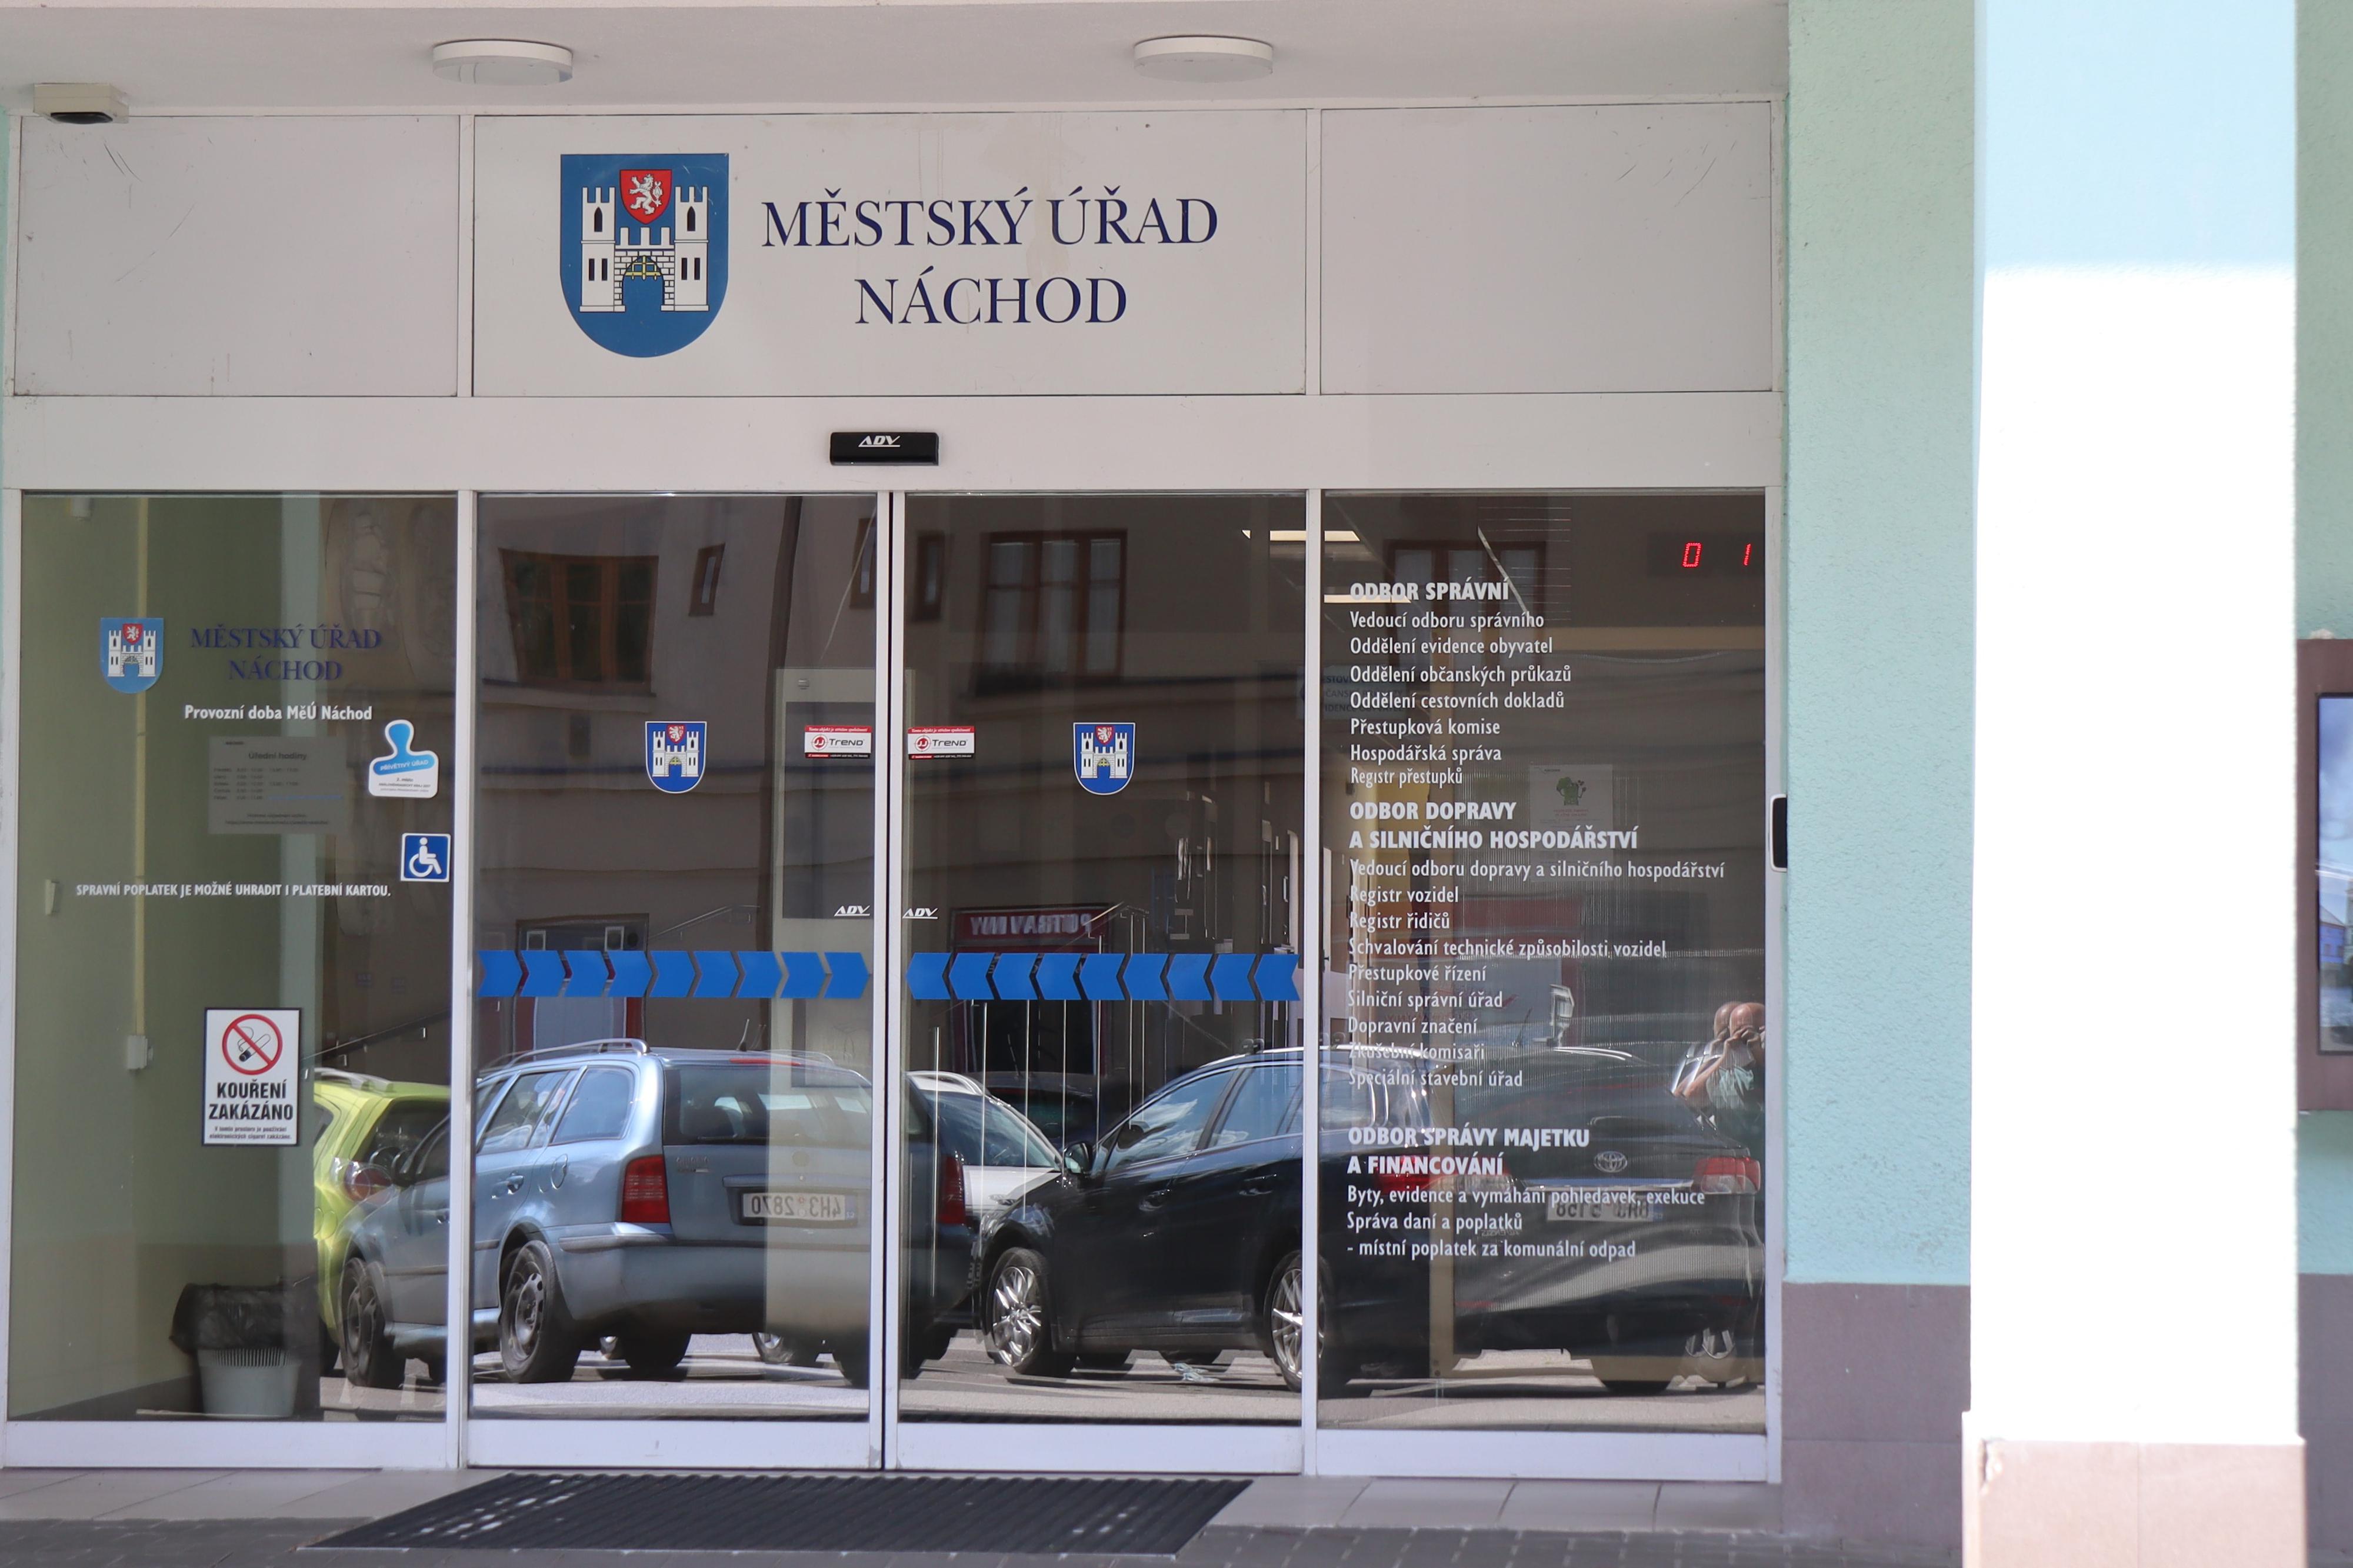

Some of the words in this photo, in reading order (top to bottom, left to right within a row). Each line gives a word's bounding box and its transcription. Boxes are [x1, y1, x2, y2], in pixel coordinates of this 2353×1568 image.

[761, 186, 1034, 248] MĚSTSKÝ
[1045, 185, 1218, 245] ÚŘAD
[854, 265, 1127, 325] NÁCHOD
[858, 435, 901, 448] ADV
[1350, 582, 1419, 600] ODBOR
[1425, 578, 1509, 600] SPRÁVNÍ
[1350, 611, 1407, 628] Vedoucí
[1412, 613, 1464, 628] odboru
[1470, 611, 1544, 632] správního
[191, 623, 305, 648] MĚSTSKÝ
[309, 623, 382, 648] ÚŘAD
[1350, 637, 1415, 654] Oddělení
[1421, 639, 1484, 653] evidence
[1489, 637, 1552, 658] obyvatel
[228, 655, 342, 680] NÁCHOD
[1350, 665, 1415, 683] Oddělení
[1420, 665, 1505, 686] občanských
[1511, 665, 1572, 686] průkazů
[185, 705, 245, 719] Provozní
[248, 705, 282, 720] doba
[287, 701, 316, 720] MěÚ
[321, 705, 372, 720] Náchod
[1350, 692, 1416, 709] Oddělení
[1421, 692, 1498, 708] cestovních
[1504, 691, 1564, 708] dokladů
[1350, 718, 1442, 739] Přestupková
[1448, 718, 1501, 735] komise
[1350, 744, 1447, 765] Hospodářská
[1452, 745, 1502, 765] správa
[1351, 768, 1395, 788] Registr
[1399, 767, 1463, 789] přestupků
[1350, 802, 1418, 819] ODBOR
[1425, 801, 1517, 819] DOPRAVY
[1349, 831, 1363, 849] A
[1369, 825, 1483, 849] SILNIČNÍHO
[1490, 825, 1639, 849] HOSPODÁŘSTVÍ
[1349, 859, 1407, 876] Vedoucí
[1412, 862, 1465, 876] odboru
[1471, 860, 1531, 881] dopravy
[1536, 866, 1544, 877] a
[1550, 860, 1622, 878] silničního
[1627, 862, 1725, 882] hospodářství
[76, 882, 121, 896] SPRAVNÍ
[124, 884, 178, 896] POPLATEK
[180, 884, 192, 898] JE
[195, 880, 232, 896] MOŽNÉ
[235, 885, 282, 896] UHRADIT
[285, 885, 289, 896] I
[294, 882, 343, 896] PLATEBNÍ
[345, 885, 391, 897] KARTOU.
[1349, 886, 1402, 906] Registr
[1407, 886, 1458, 903] vozidel
[834, 905, 871, 916] ADV
[902, 908, 938, 919] ADV
[1349, 912, 1402, 932] Registr
[1407, 912, 1450, 929] řidičů
[1348, 939, 1439, 957] Schvalování
[1444, 939, 1514, 957] technické
[1518, 940, 1609, 960] způsobilosti
[1613, 940, 1666, 958] vozidel
[1349, 965, 1439, 984] Přestupkové
[1444, 965, 1487, 982] řízení
[1348, 991, 1402, 1007] Silniční
[1407, 992, 1464, 1010] správní
[1468, 992, 1502, 1008] úřad
[1348, 1017, 1416, 1037] Dopravní
[1420, 1019, 1477, 1035] značení
[1420, 1043, 1484, 1060] komisaři
[217, 1079, 287, 1099] KOUŘENÍ
[1348, 1069, 1416, 1089] Speciální
[1421, 1070, 1484, 1087] stavební
[1488, 1070, 1522, 1087] úřad
[208, 1100, 294, 1120] ZAKÁZÁNO
[1348, 1127, 1417, 1145] ODBOR
[1424, 1122, 1498, 1147] SPRÁVY
[1504, 1129, 1589, 1152] MAJETKU
[1347, 1157, 1361, 1174] A
[1367, 1152, 1503, 1176] FINANCOVÁNÍ
[1347, 1186, 1384, 1206] Byty,
[1389, 1187, 1454, 1203] evidence
[1458, 1192, 1467, 1203] a
[1472, 1188, 1546, 1208] vymáhání
[1551, 1188, 1642, 1208] pohledávek,
[1647, 1190, 1705, 1205] exekuce
[1347, 1213, 1398, 1233] Správa
[1404, 1213, 1437, 1229] daní
[1442, 1218, 1450, 1230] a
[1455, 1213, 1522, 1234] poplatků
[1359, 1240, 1406, 1256] místní
[1412, 1240, 1476, 1260] poplatek
[1482, 1244, 1498, 1257] za
[1504, 1240, 1584, 1257] komunální
[1589, 1241, 1635, 1262] odpad
